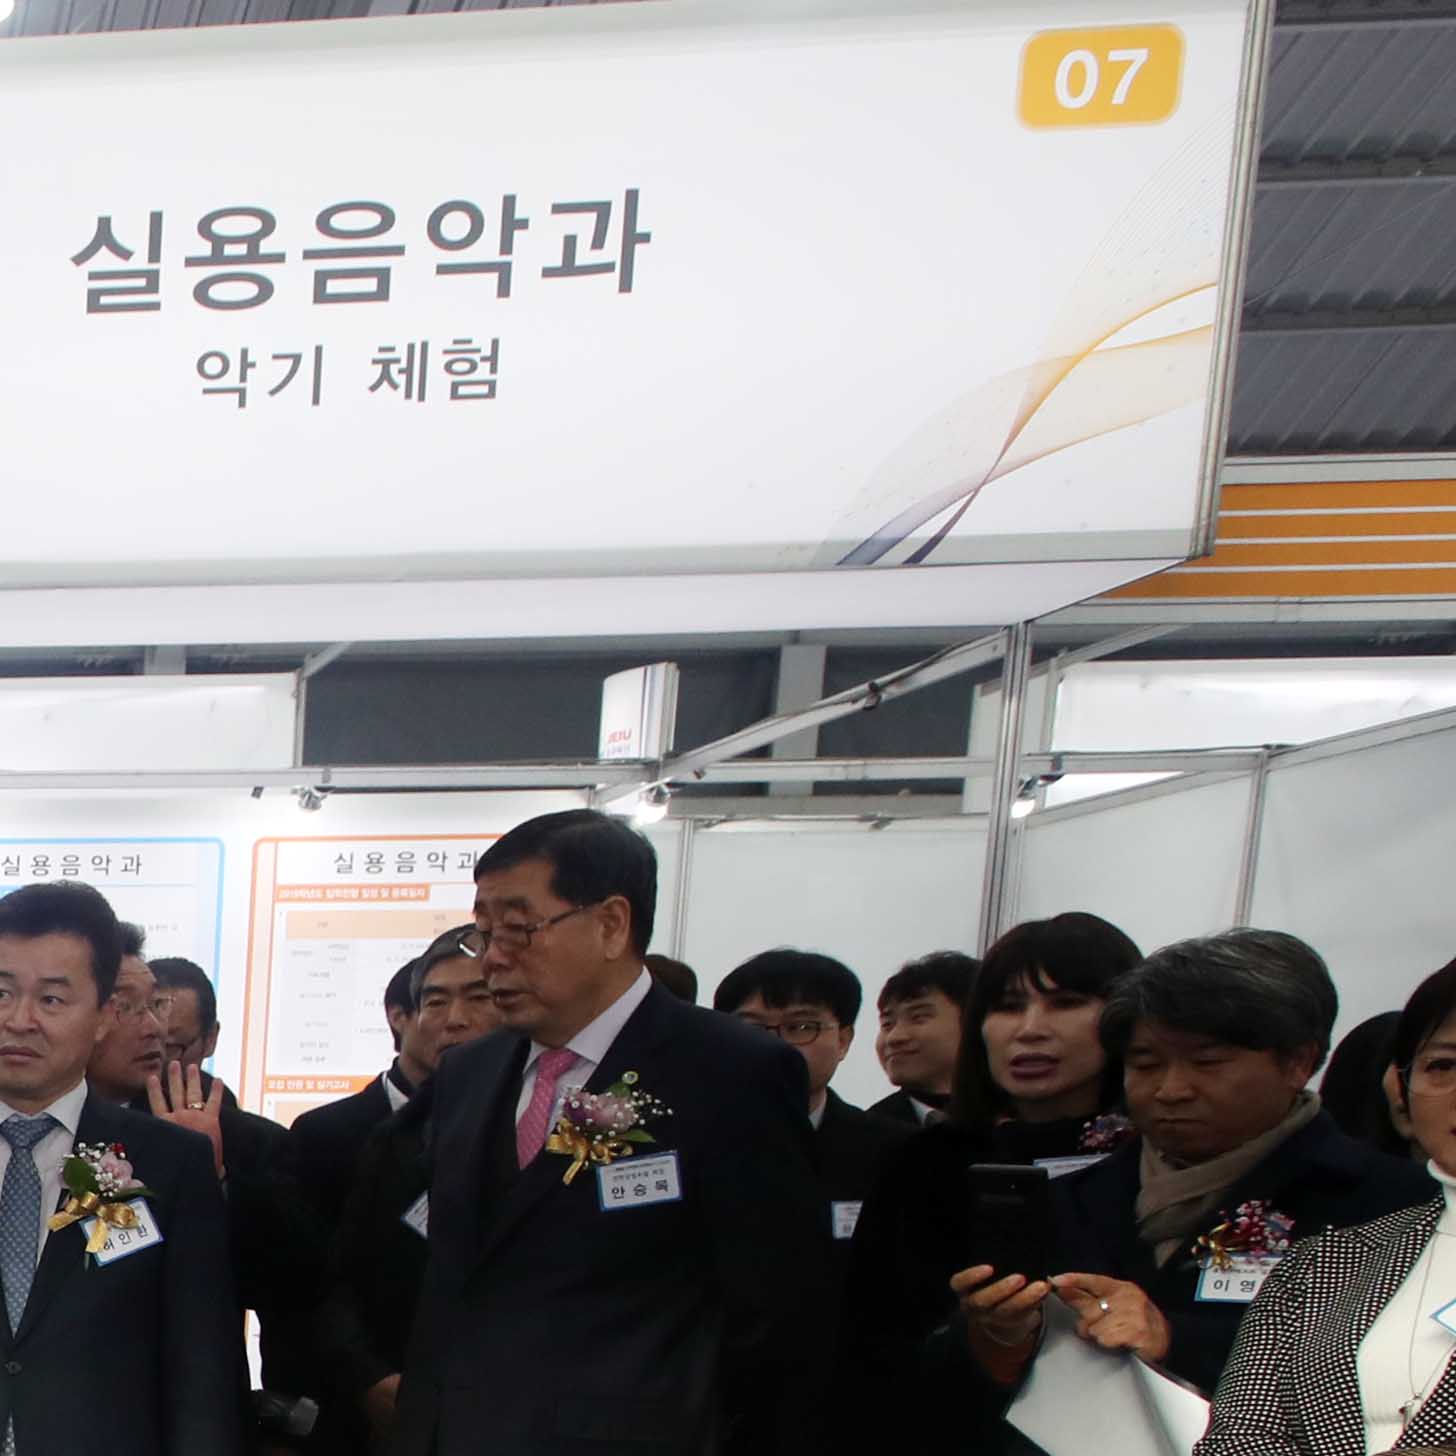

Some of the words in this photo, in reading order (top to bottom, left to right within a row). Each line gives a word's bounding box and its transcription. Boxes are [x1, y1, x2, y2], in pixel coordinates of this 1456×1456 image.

[1055, 47, 1149, 110] 07
[69, 187, 653, 316] 실용음악과
[194, 343, 325, 409] 악기
[367, 336, 501, 403] 체험
[0, 853, 144, 878] 실용음악과
[1213, 1279, 1256, 1293] 이영
